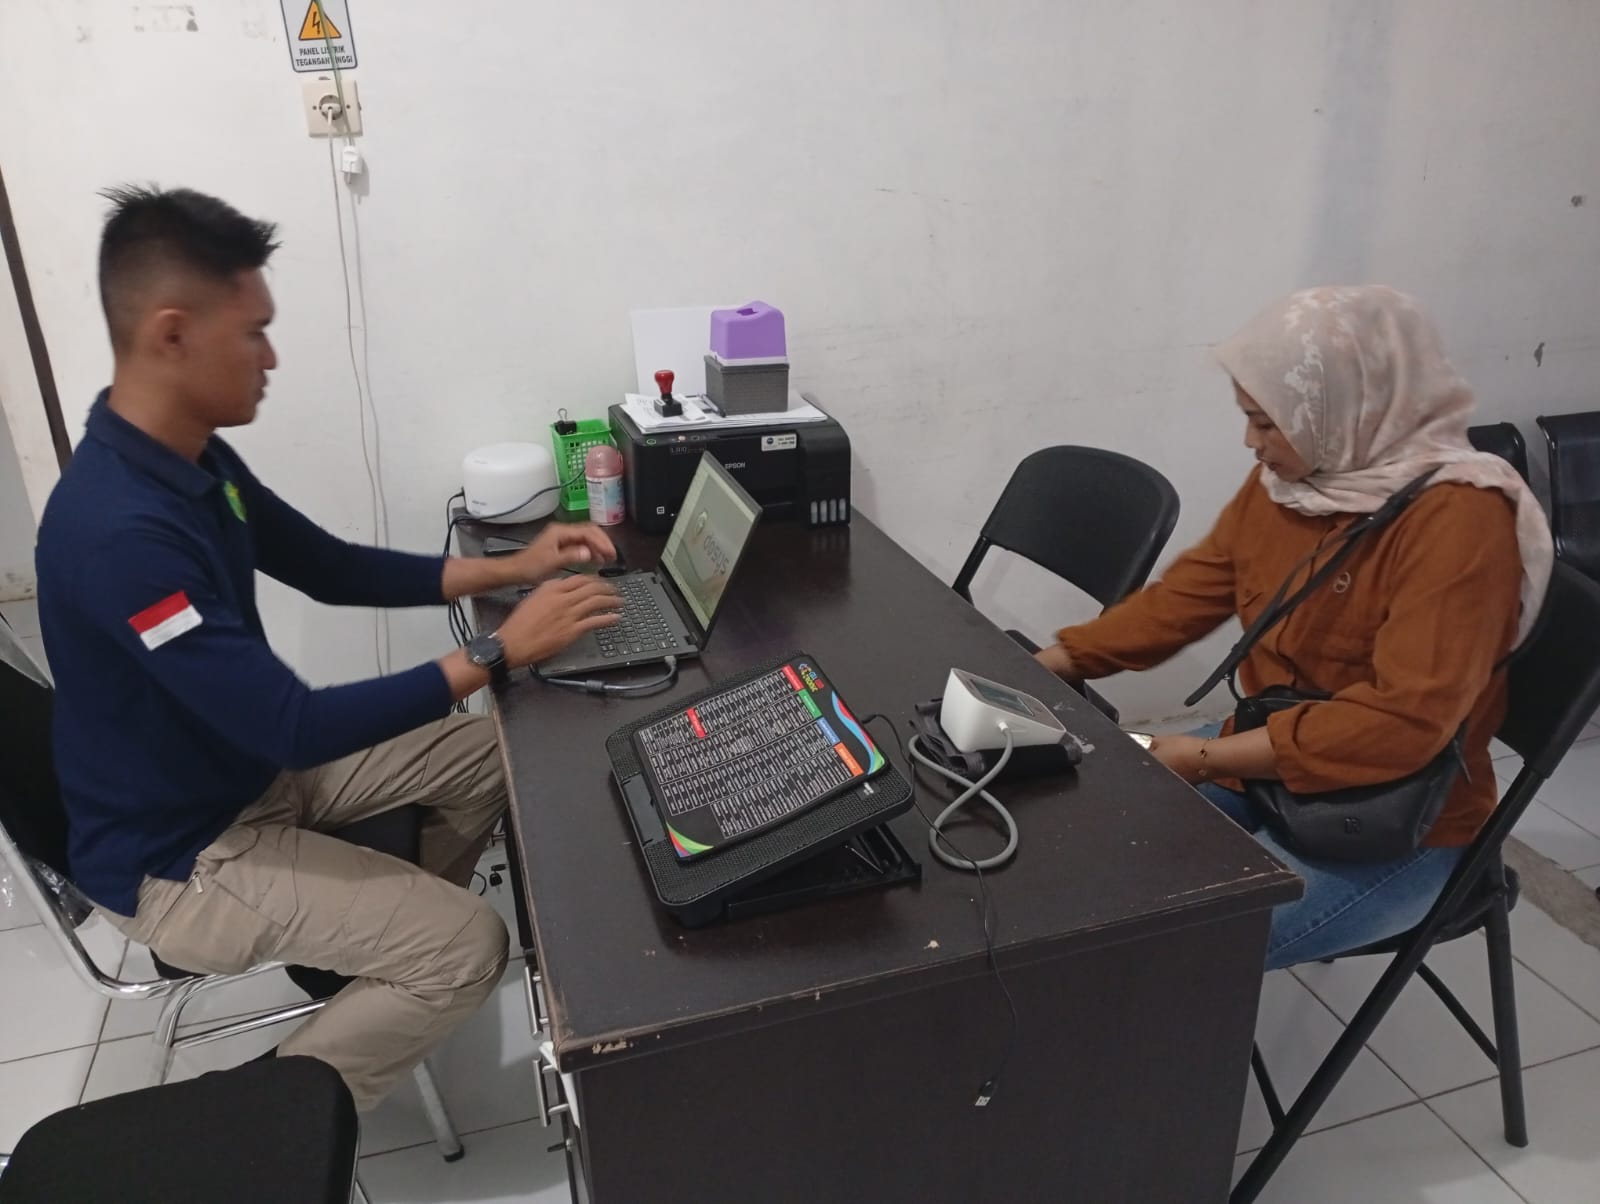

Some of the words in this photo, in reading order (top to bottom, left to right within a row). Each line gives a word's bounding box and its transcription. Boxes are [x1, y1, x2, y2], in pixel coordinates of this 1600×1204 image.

[299, 47, 319, 56] PANEL
[320, 45, 345, 55] LISRIK
[296, 57, 330, 67] TEGANGAN
[331, 55, 353, 64] INGGI
